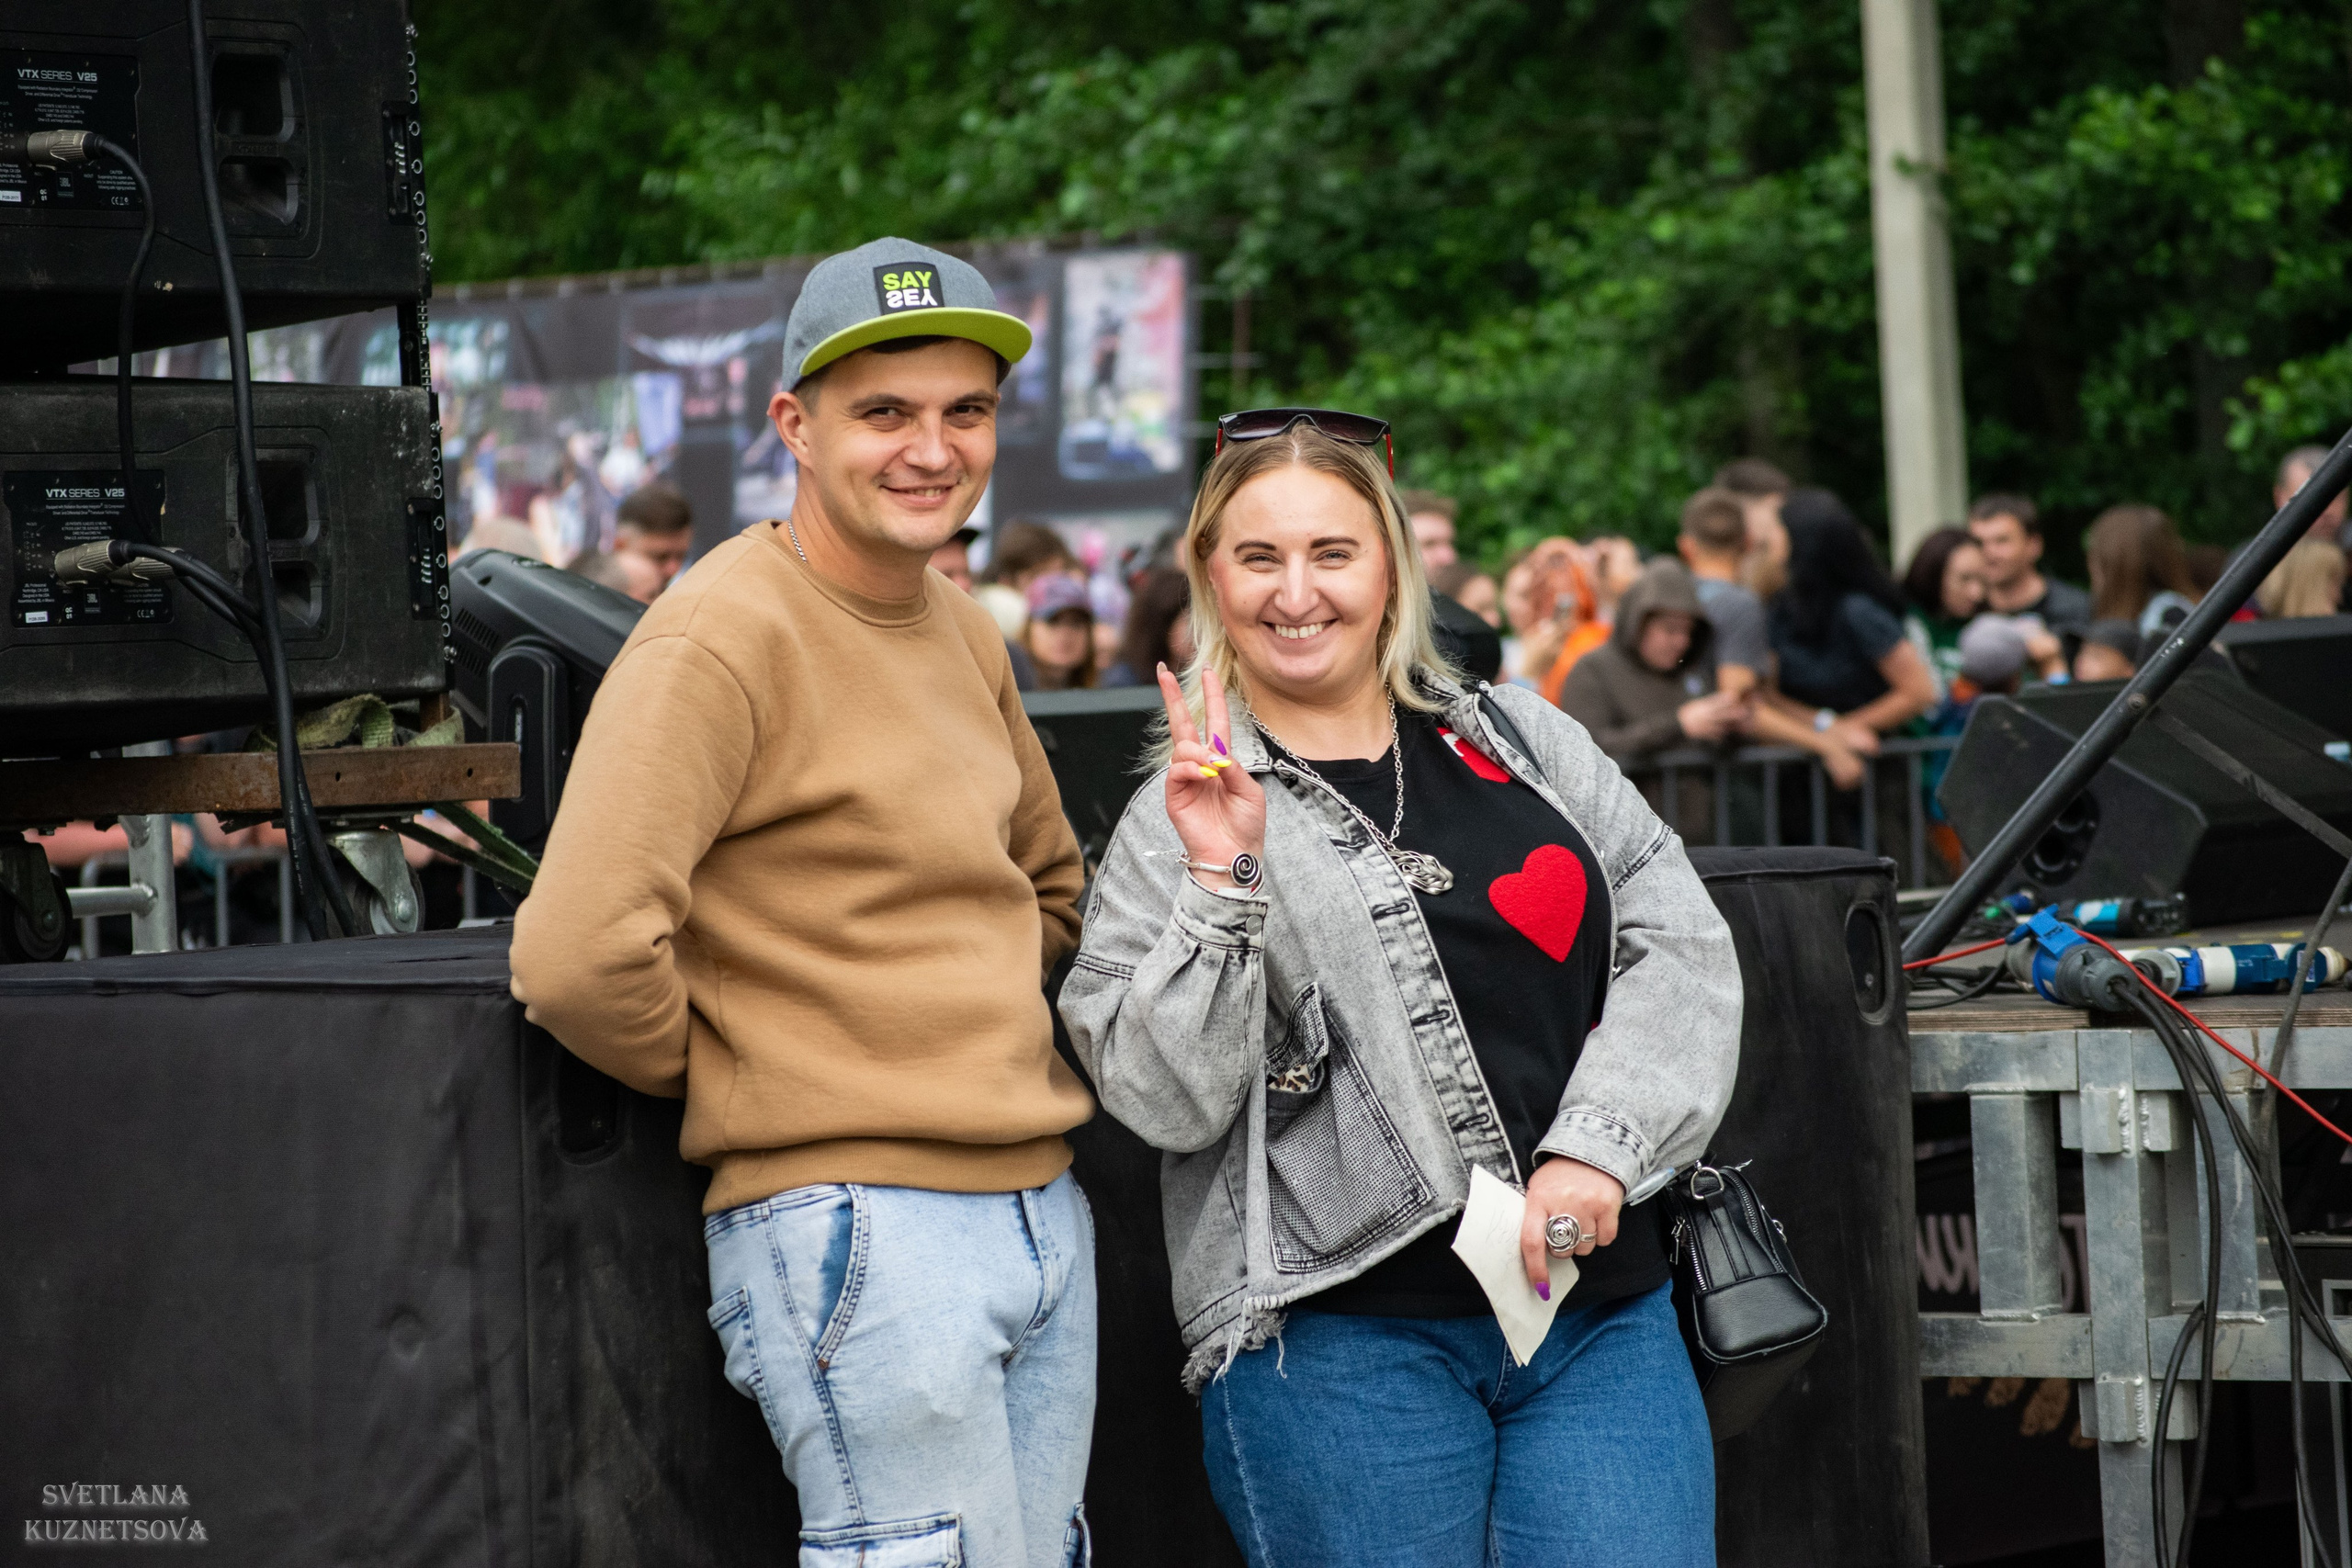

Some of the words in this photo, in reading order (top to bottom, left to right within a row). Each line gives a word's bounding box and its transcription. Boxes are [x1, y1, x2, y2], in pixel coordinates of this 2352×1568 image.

[17, 68, 40, 79] VTX
[40, 71, 73, 81] SERIES
[77, 72, 98, 82] V25
[882, 270, 932, 291] SAY
[45, 488, 68, 498] VTX
[68, 488, 100, 498] SERIES
[104, 488, 125, 498] V25
